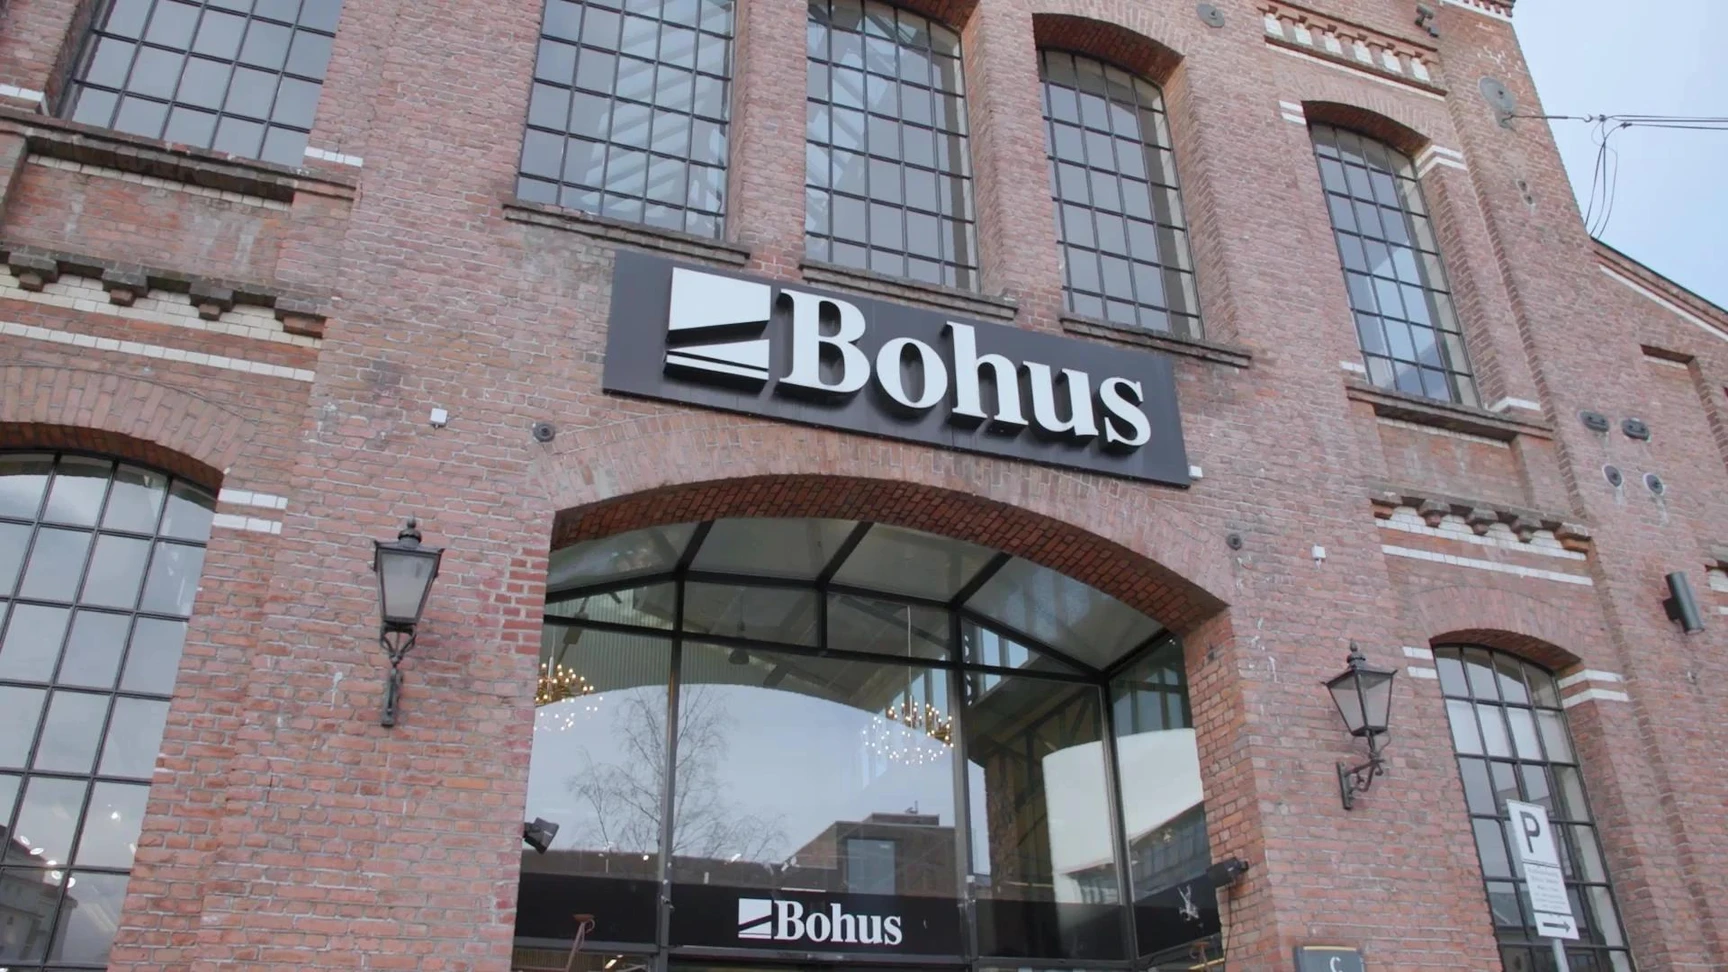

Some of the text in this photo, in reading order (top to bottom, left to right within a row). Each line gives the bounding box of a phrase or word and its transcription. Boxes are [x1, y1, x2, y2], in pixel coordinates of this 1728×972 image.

[777, 288, 1152, 448] Bohus
[1519, 810, 1541, 854] P
[773, 900, 903, 945] Bohus
